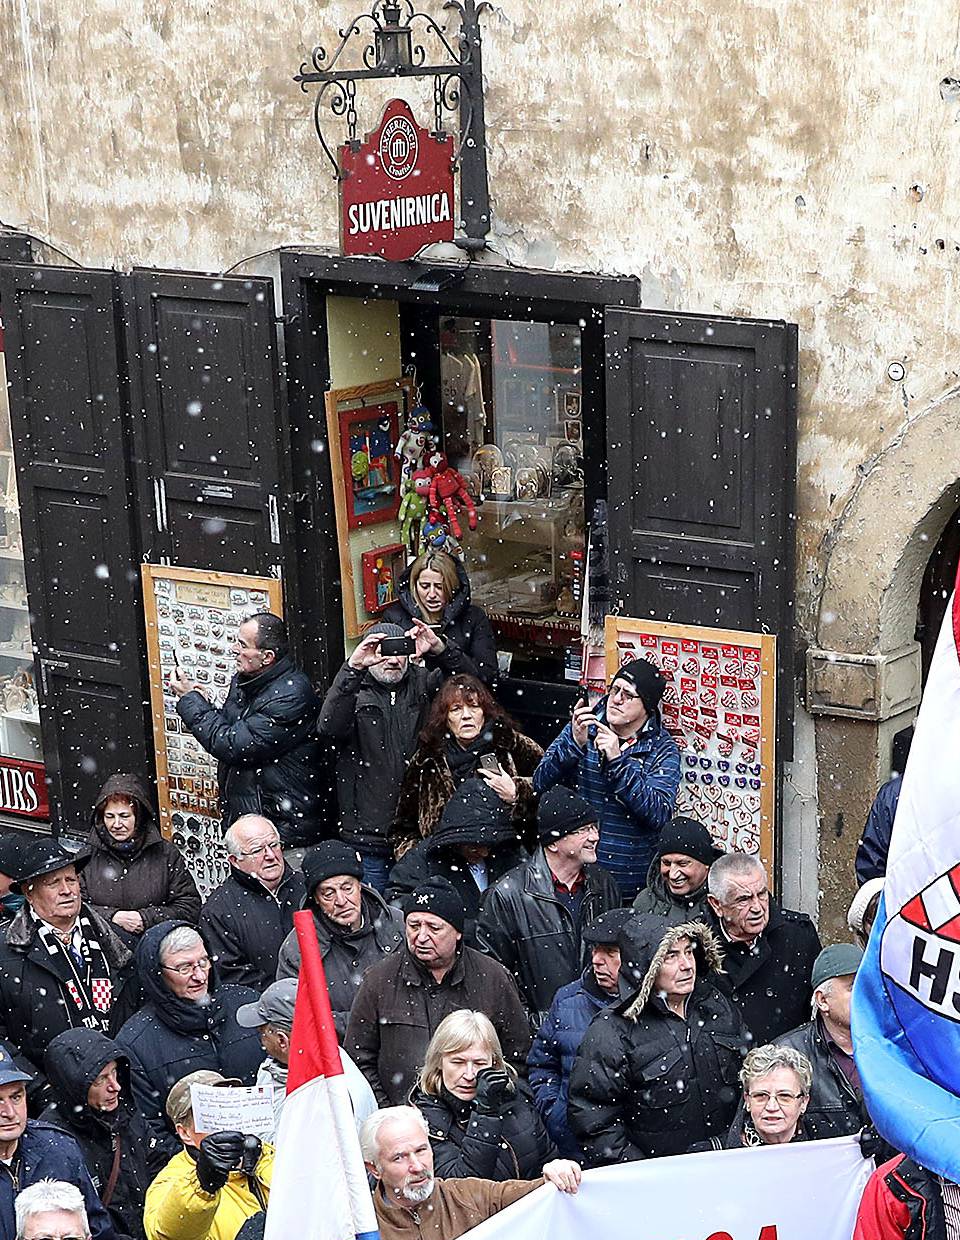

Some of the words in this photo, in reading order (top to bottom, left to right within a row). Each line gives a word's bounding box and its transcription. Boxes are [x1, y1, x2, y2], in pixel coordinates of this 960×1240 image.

[382, 118, 416, 153] EXPERIENCE
[348, 192, 451, 235] SUVENIRNICA
[0, 767, 38, 812] IRS
